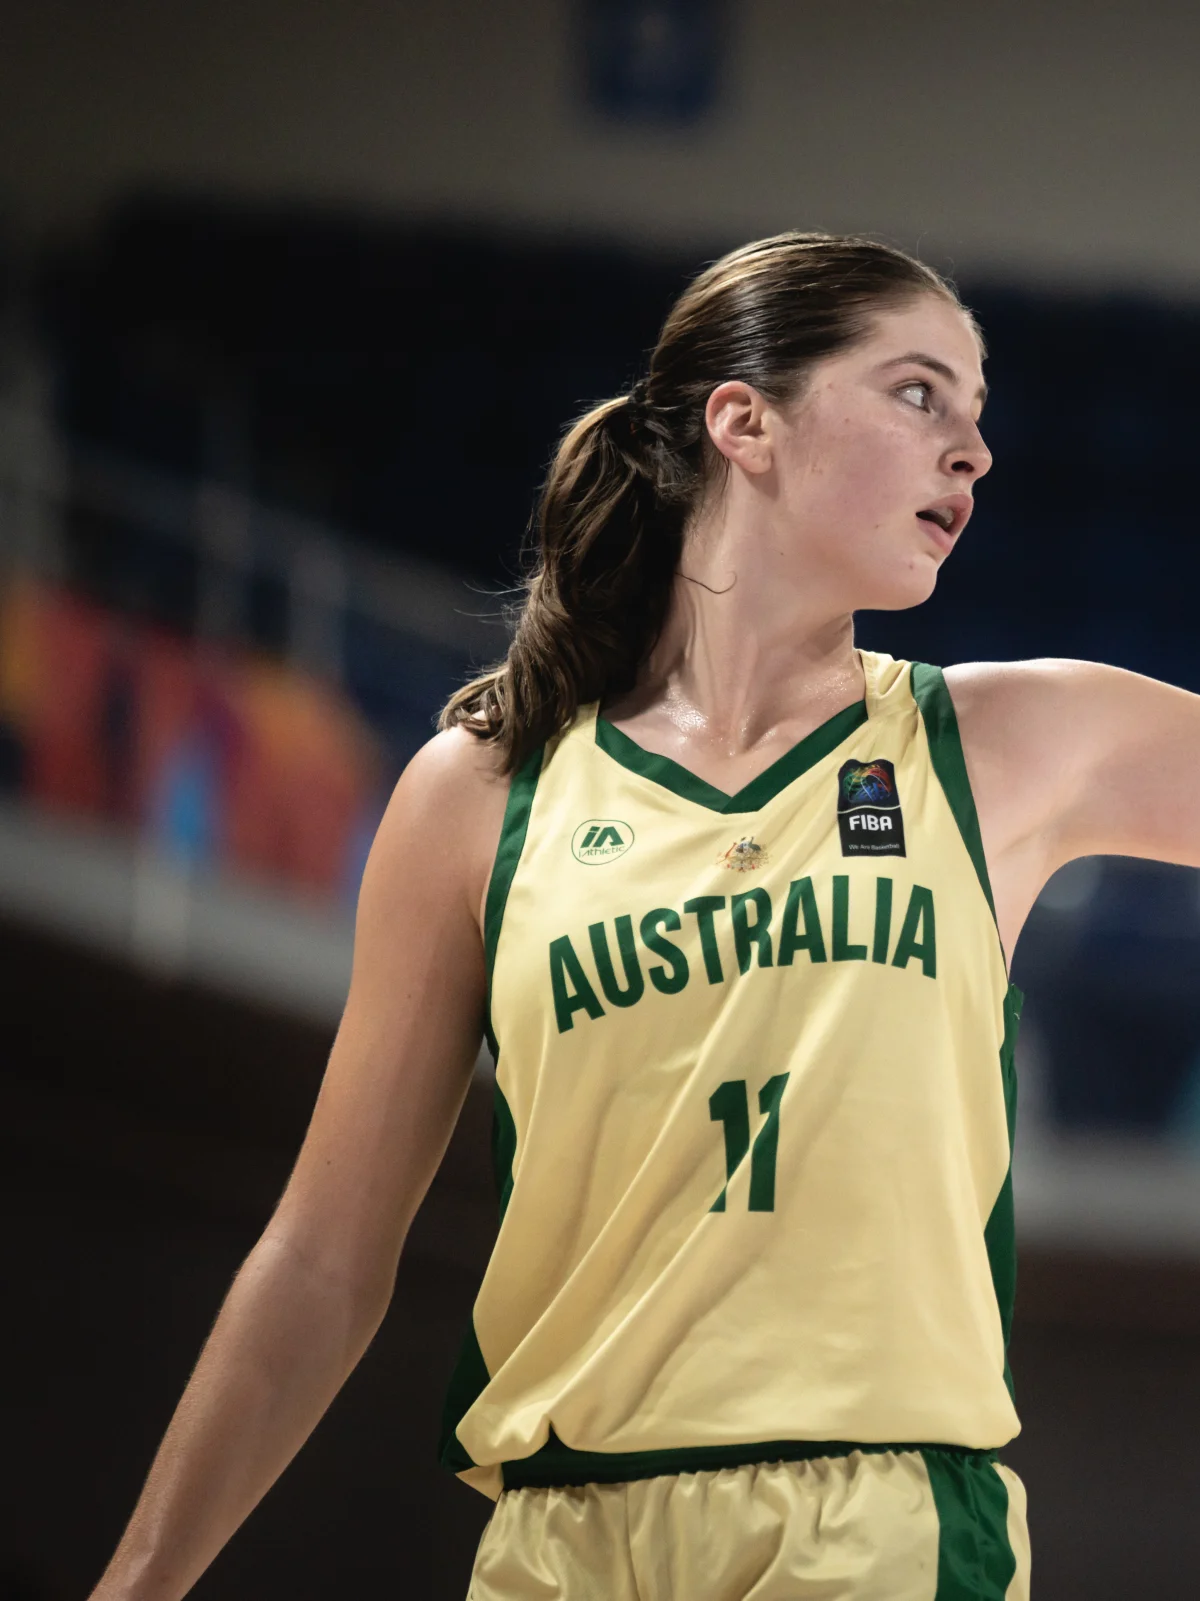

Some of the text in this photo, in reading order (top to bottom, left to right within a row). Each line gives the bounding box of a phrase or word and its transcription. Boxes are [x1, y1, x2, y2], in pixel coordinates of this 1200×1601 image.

[849, 814, 893, 831] FIBA
[549, 875, 937, 1034] AUSTRALIA
[708, 1071, 790, 1212] 11
